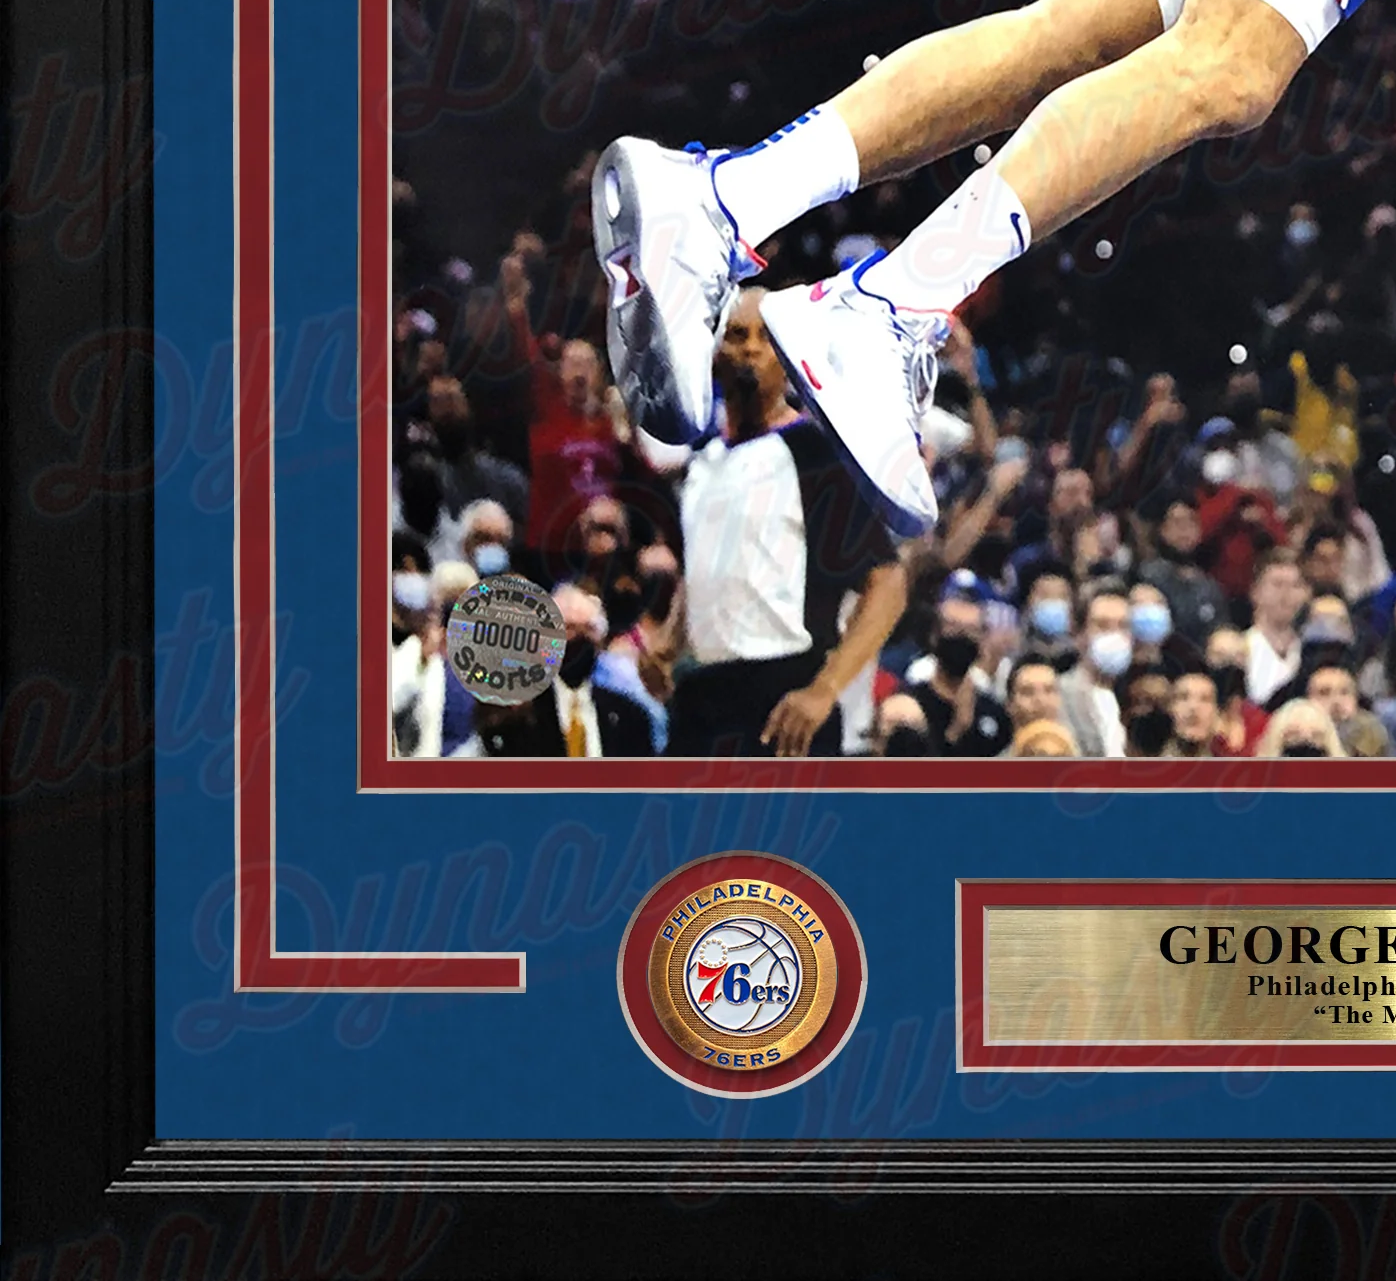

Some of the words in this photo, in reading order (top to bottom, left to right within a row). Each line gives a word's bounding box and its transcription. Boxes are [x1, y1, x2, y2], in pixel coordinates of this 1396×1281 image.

[473, 620, 540, 653] 00000
[453, 646, 546, 690] Sports
[661, 883, 825, 945] PHILADELPHIA
[696, 961, 791, 1006] 76ers
[1313, 1004, 1374, 1025] “The
[702, 1046, 782, 1068] 76ERS
